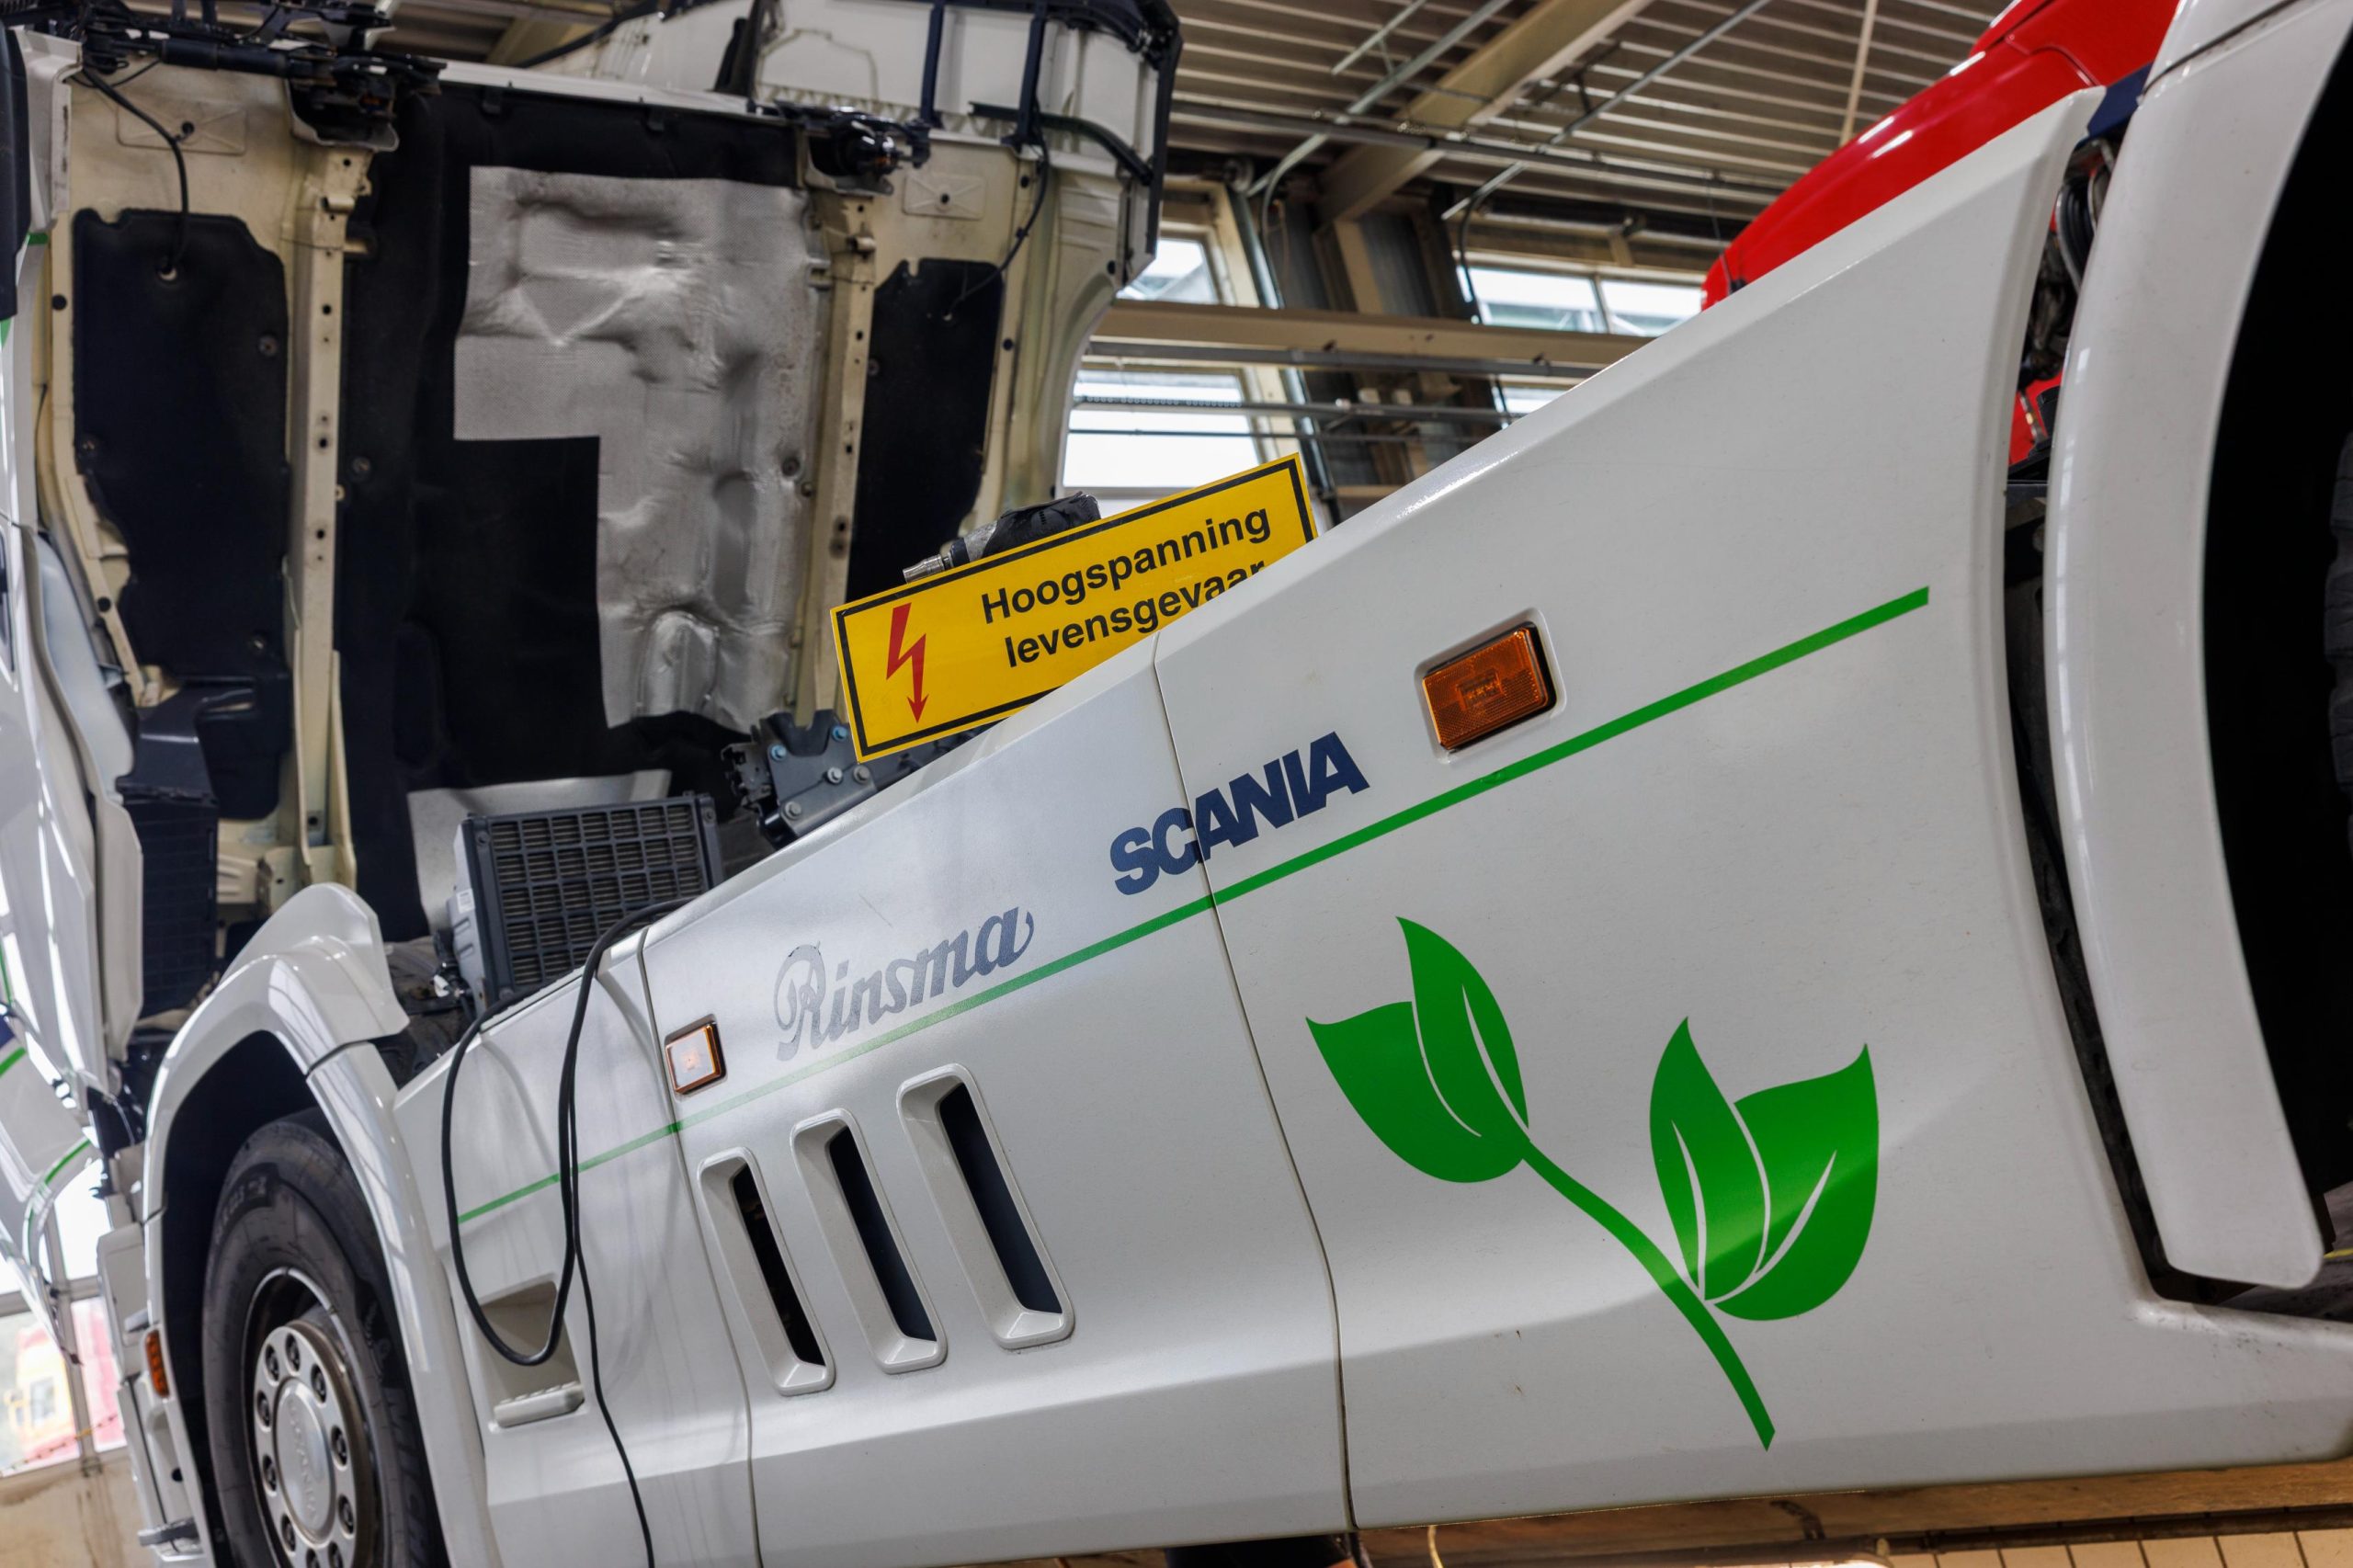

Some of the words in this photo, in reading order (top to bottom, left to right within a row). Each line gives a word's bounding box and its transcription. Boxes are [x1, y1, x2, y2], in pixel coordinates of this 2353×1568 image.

[981, 507, 1271, 624] Hoogspanning
[1109, 732, 1370, 895] SCANIA
[775, 907, 1034, 1060] Rinsma
